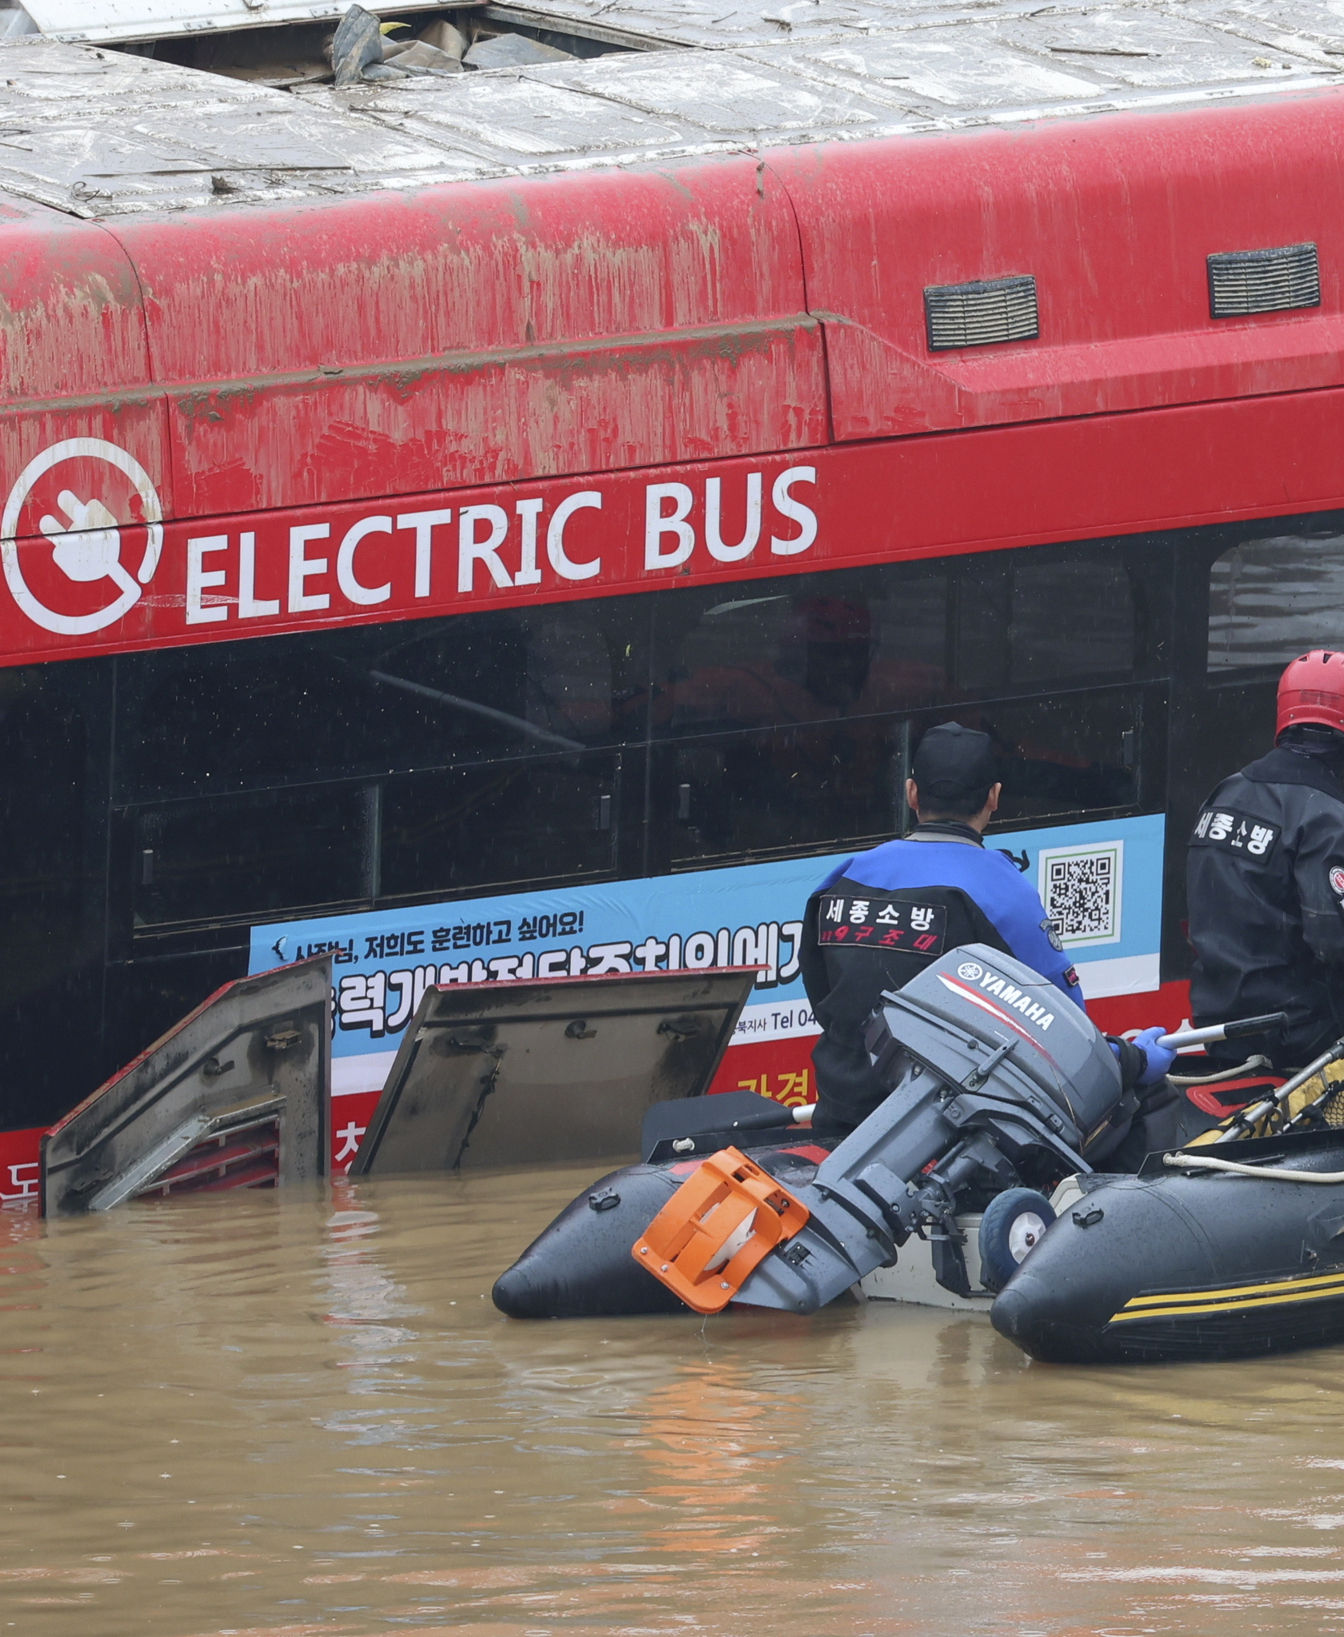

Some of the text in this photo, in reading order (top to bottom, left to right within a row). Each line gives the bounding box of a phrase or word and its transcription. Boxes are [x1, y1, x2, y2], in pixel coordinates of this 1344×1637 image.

[185, 466, 818, 626] ELECTRIC BUS
[1194, 811, 1274, 856] 세종소방
[363, 930, 425, 959] 저희도
[430, 918, 512, 950] 훈련하고
[517, 910, 585, 941] 싶어요!
[826, 899, 935, 932] 세종소방
[731, 1017, 768, 1035] 북지사
[771, 1009, 794, 1030] Tel
[981, 971, 1056, 1031] YAMAHA
